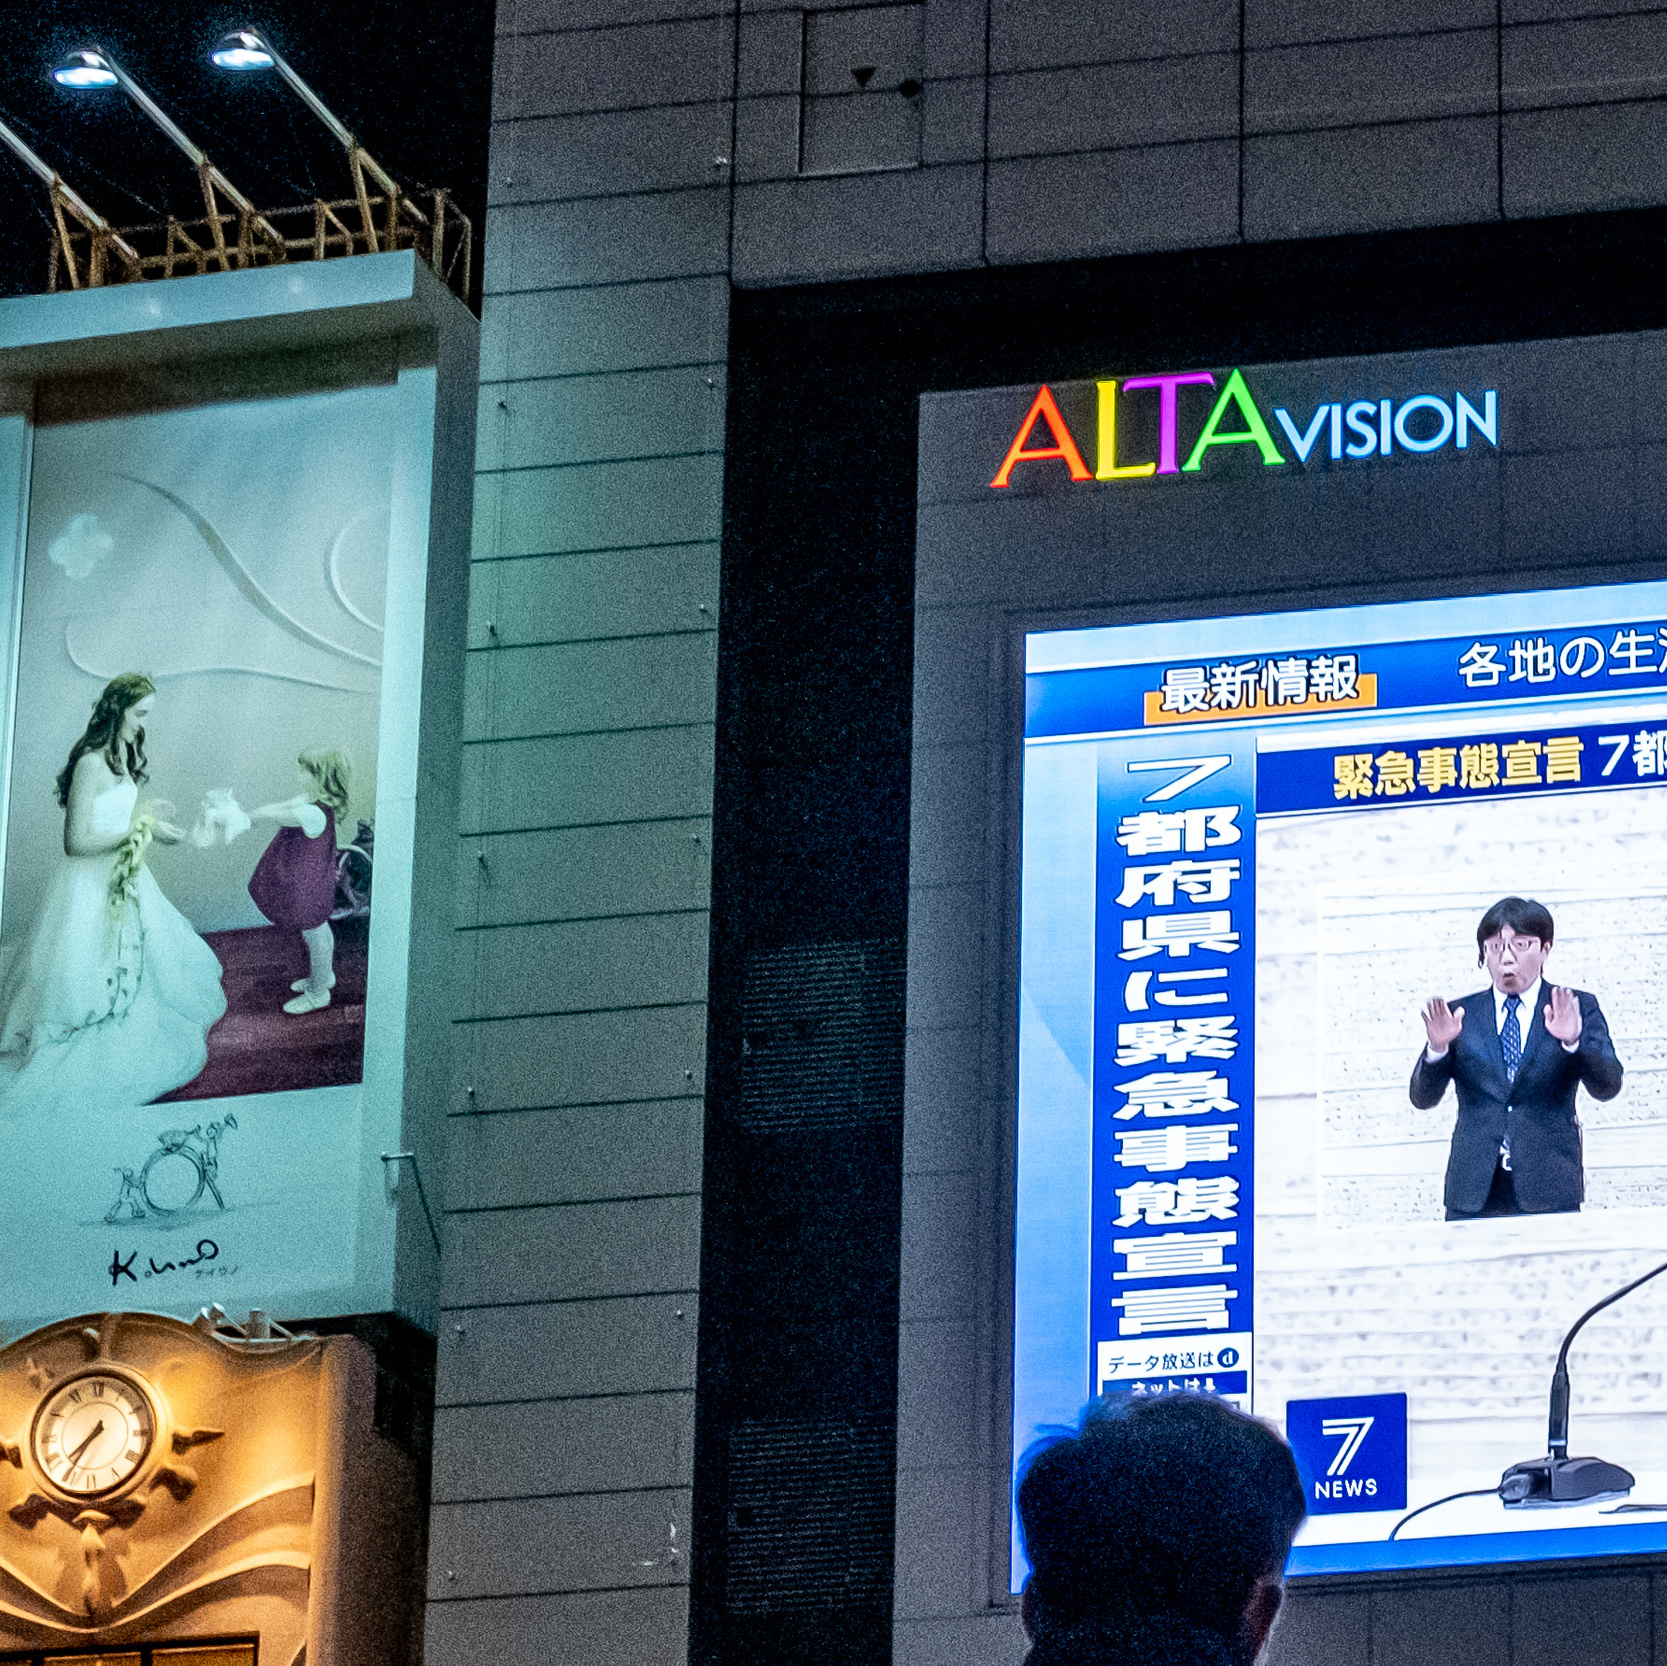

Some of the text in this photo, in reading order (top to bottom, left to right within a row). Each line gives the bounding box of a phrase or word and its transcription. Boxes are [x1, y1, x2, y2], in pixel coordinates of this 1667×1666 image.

[1161, 655, 1359, 714] 最新情報
[1333, 736, 1585, 800] 緊急事態宣言
[1113, 754, 1243, 1336] 7都府県に緊急事態宣言
[1314, 1478, 1378, 1499] NEWS
